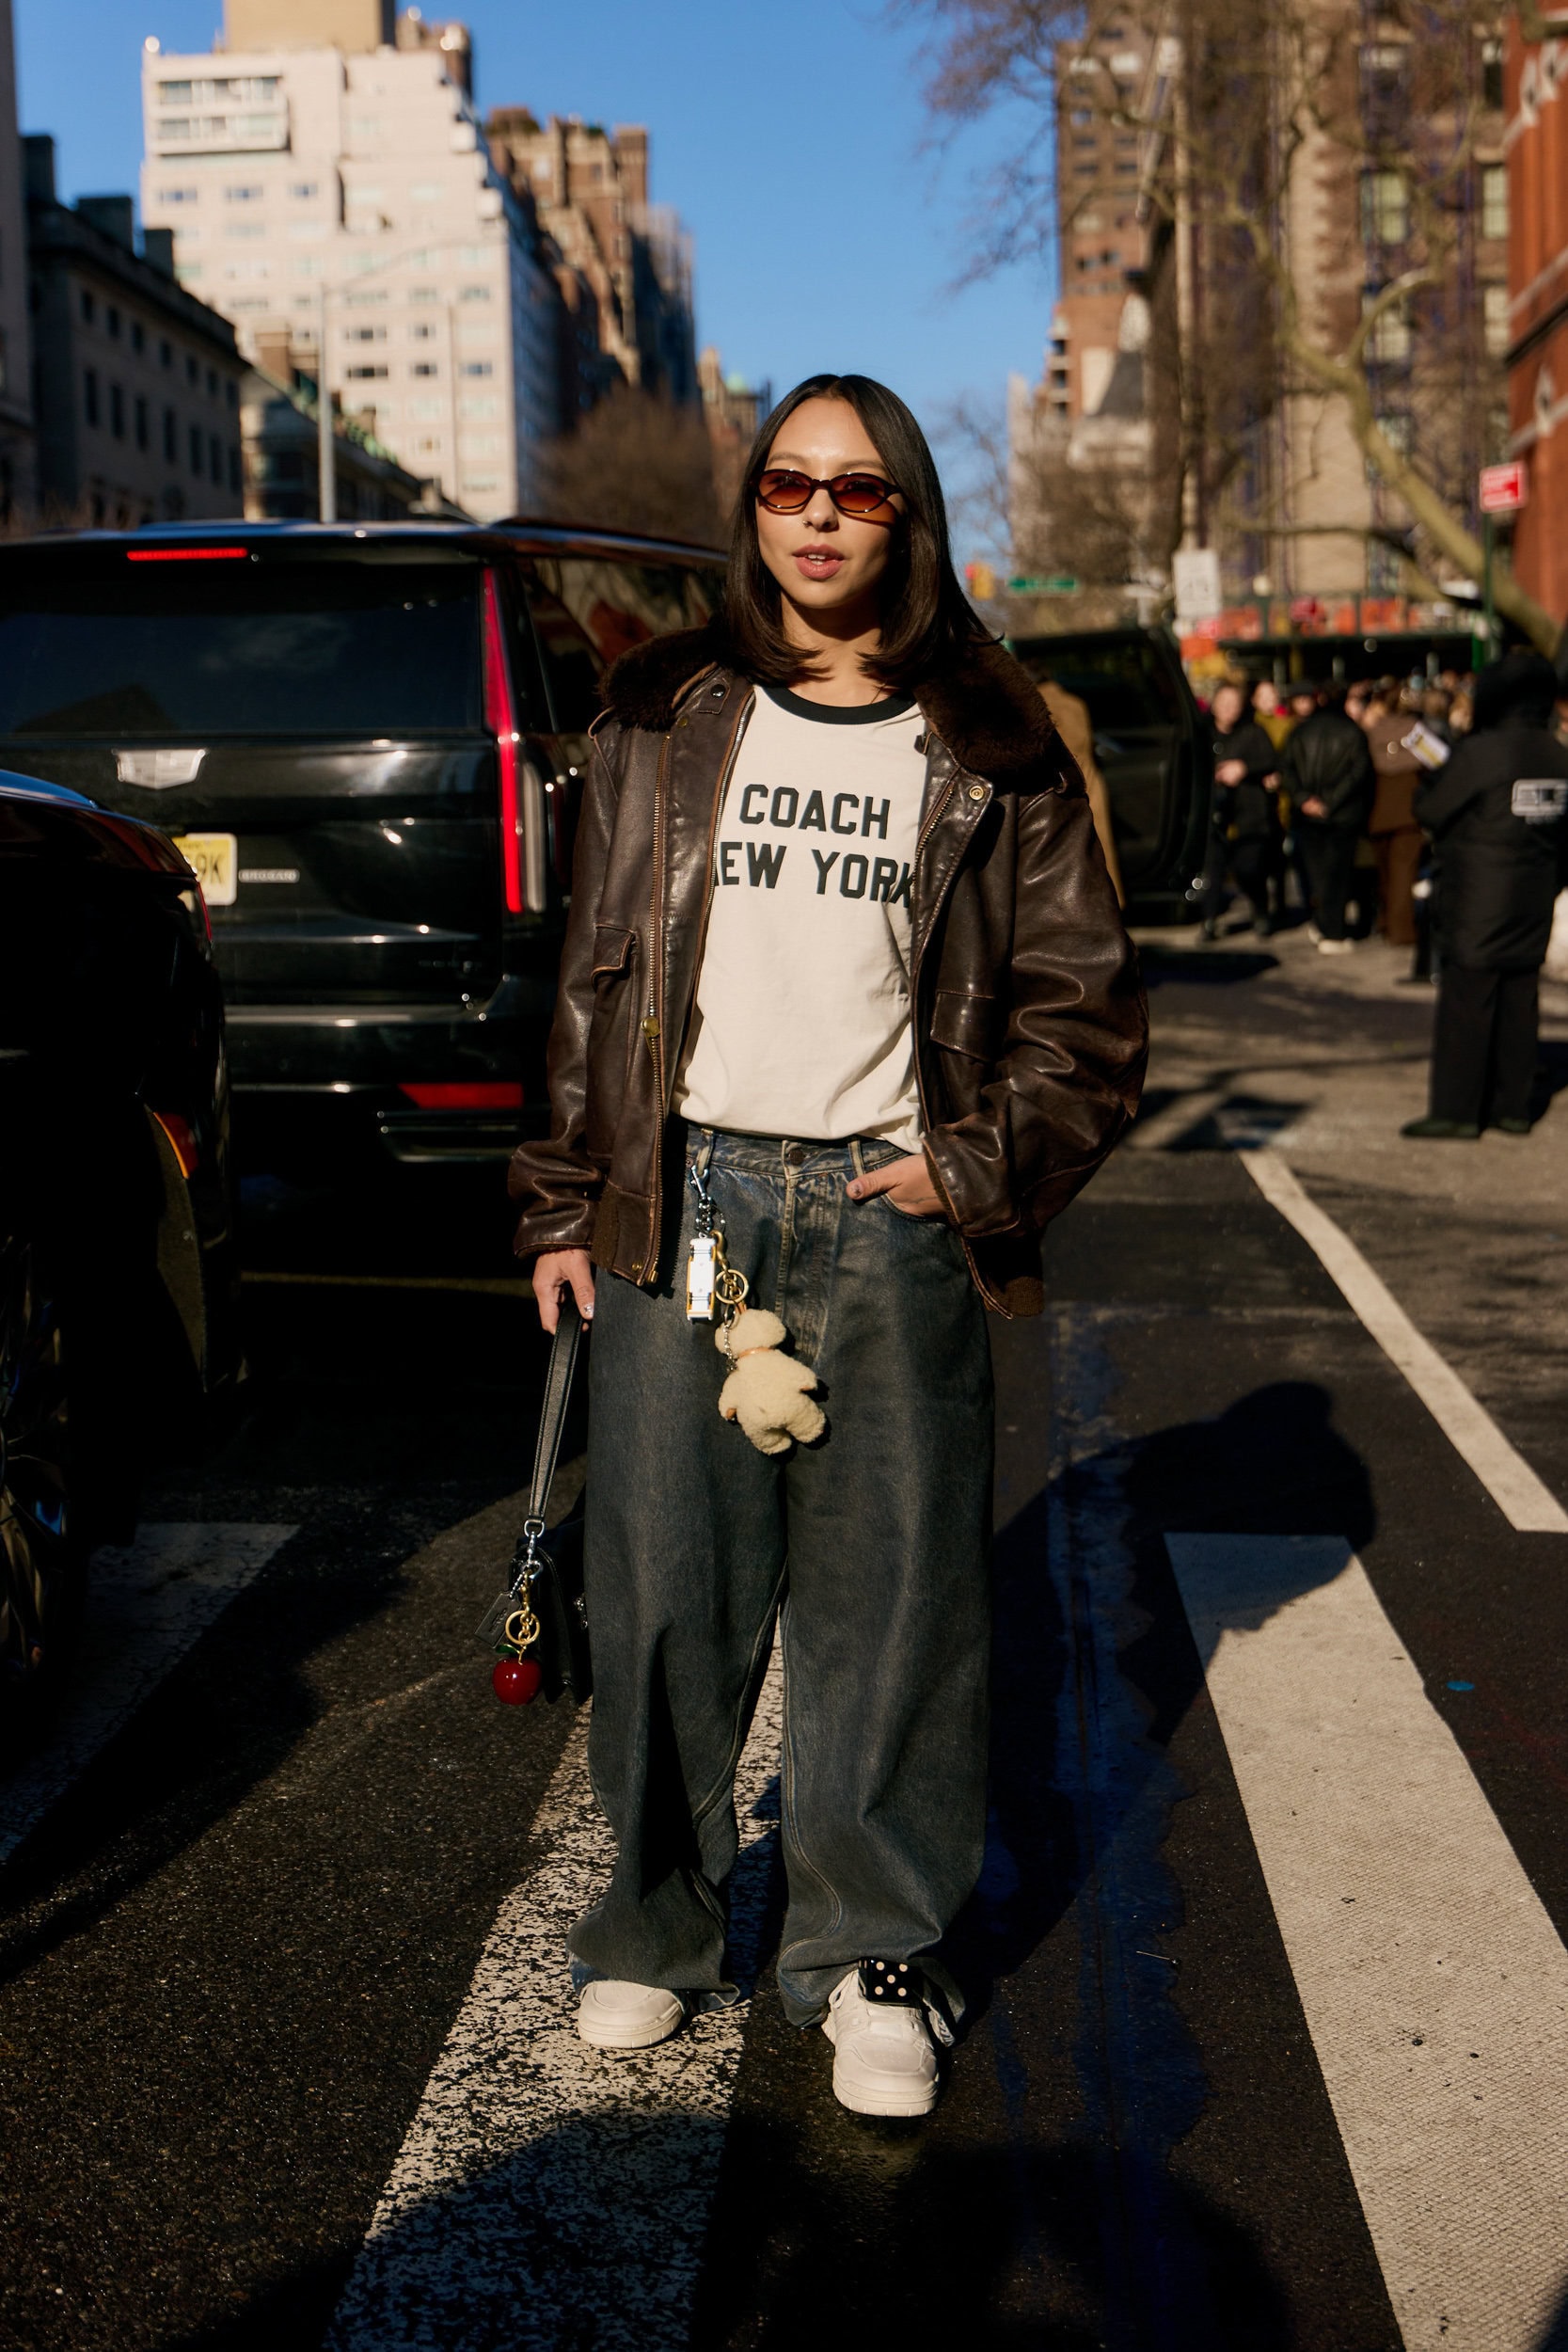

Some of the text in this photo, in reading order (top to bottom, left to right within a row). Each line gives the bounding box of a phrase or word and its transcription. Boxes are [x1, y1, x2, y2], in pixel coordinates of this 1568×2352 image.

[739, 784, 891, 839] COACH
[714, 842, 913, 908] EW YORK
